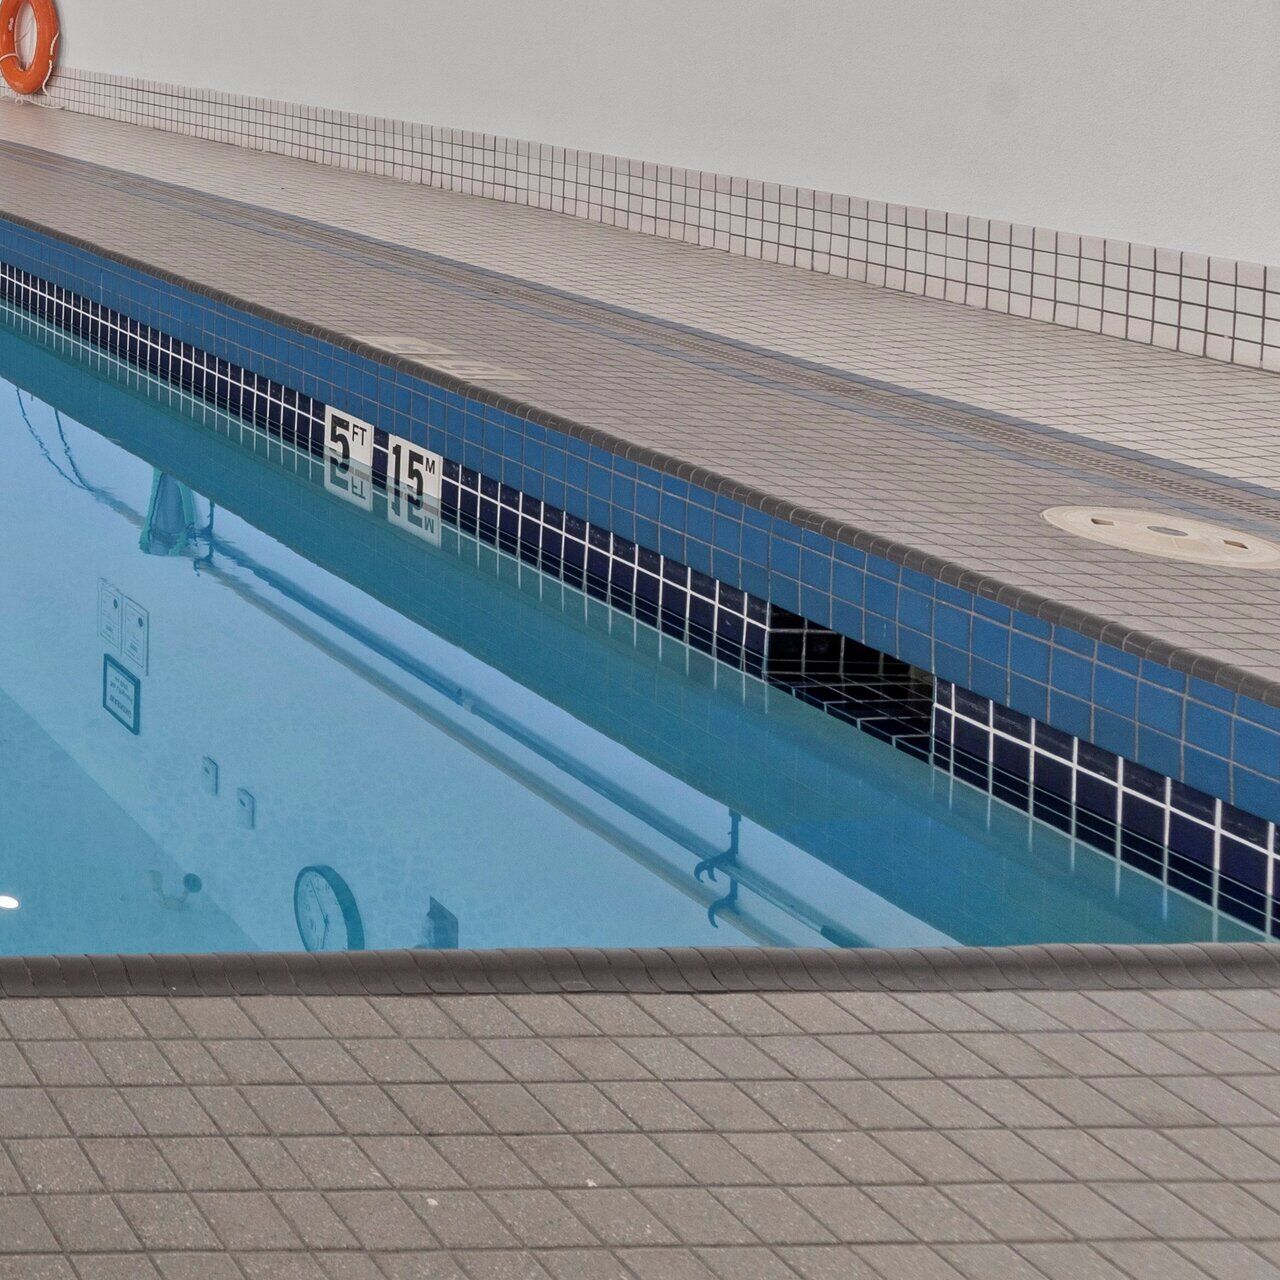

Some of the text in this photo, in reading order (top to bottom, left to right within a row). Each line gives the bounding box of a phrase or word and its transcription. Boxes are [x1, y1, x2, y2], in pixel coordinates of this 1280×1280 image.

[330, 413, 367, 471] 5 FT
[425, 457, 436, 475] M
